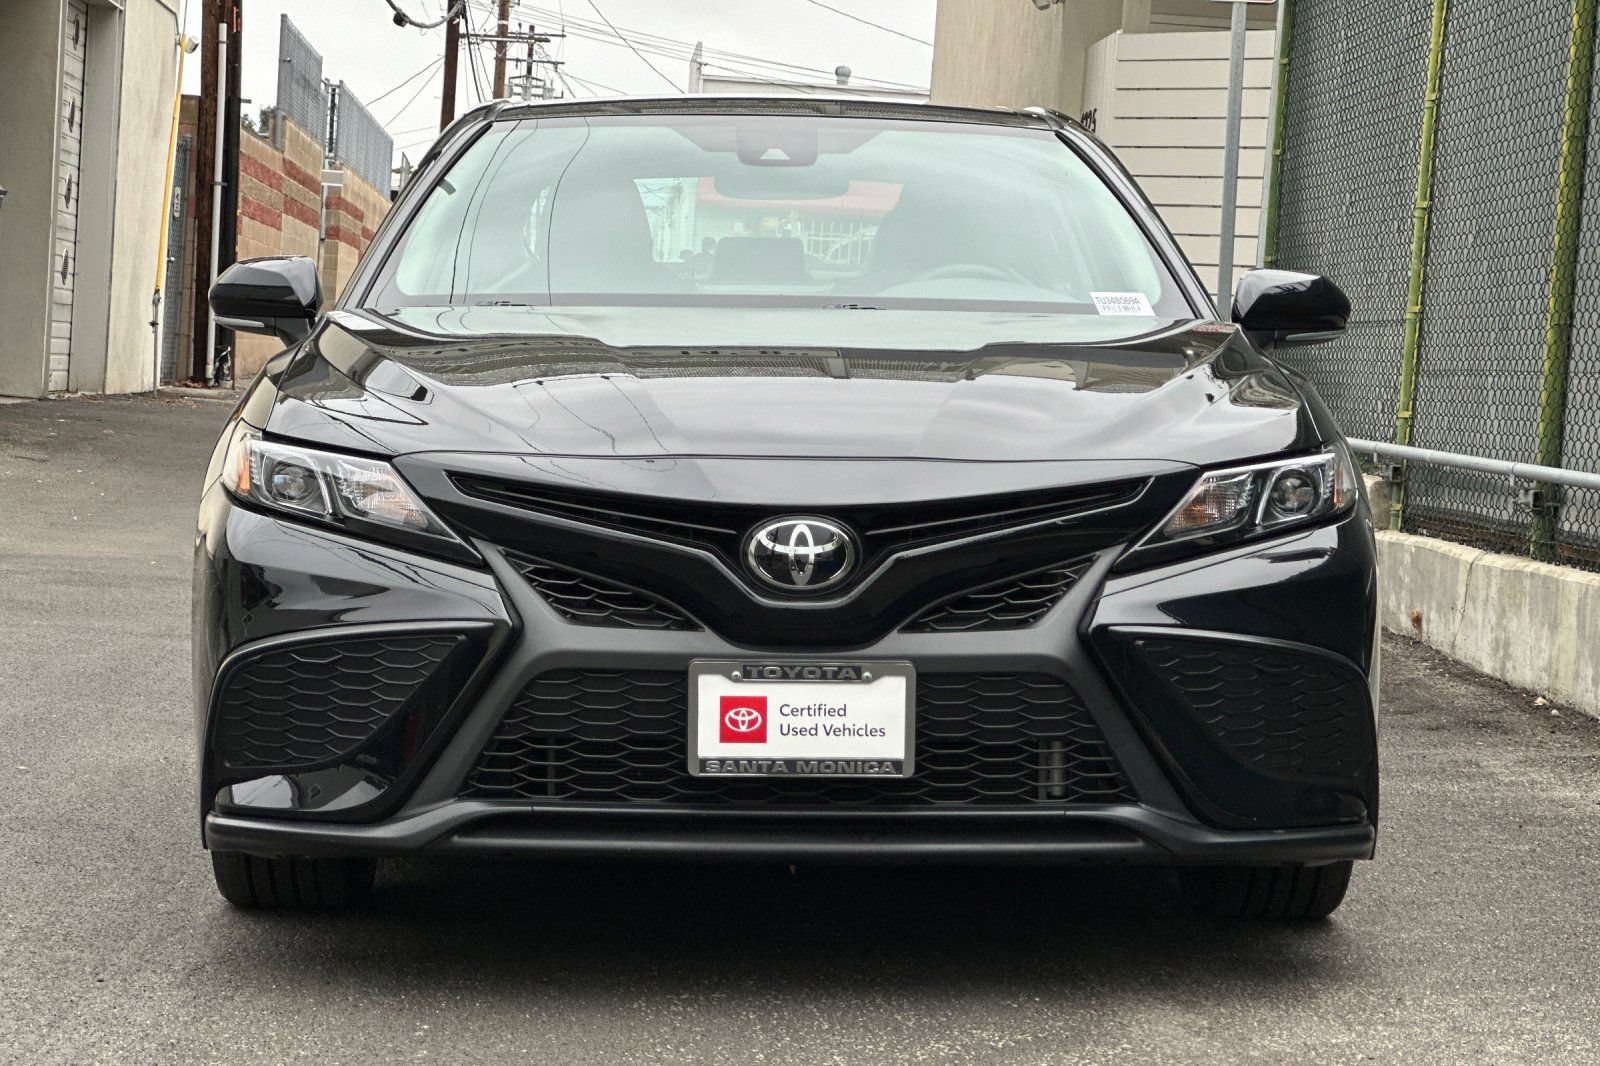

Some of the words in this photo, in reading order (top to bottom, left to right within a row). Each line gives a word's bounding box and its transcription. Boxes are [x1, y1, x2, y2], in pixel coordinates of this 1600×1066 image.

[746, 666, 857, 679] TOYOTA
[779, 704, 847, 717] Certified
[779, 723, 818, 737] Used
[823, 723, 886, 737] Vehicles
[705, 760, 789, 774] SANTA
[796, 761, 897, 774] MONICA
